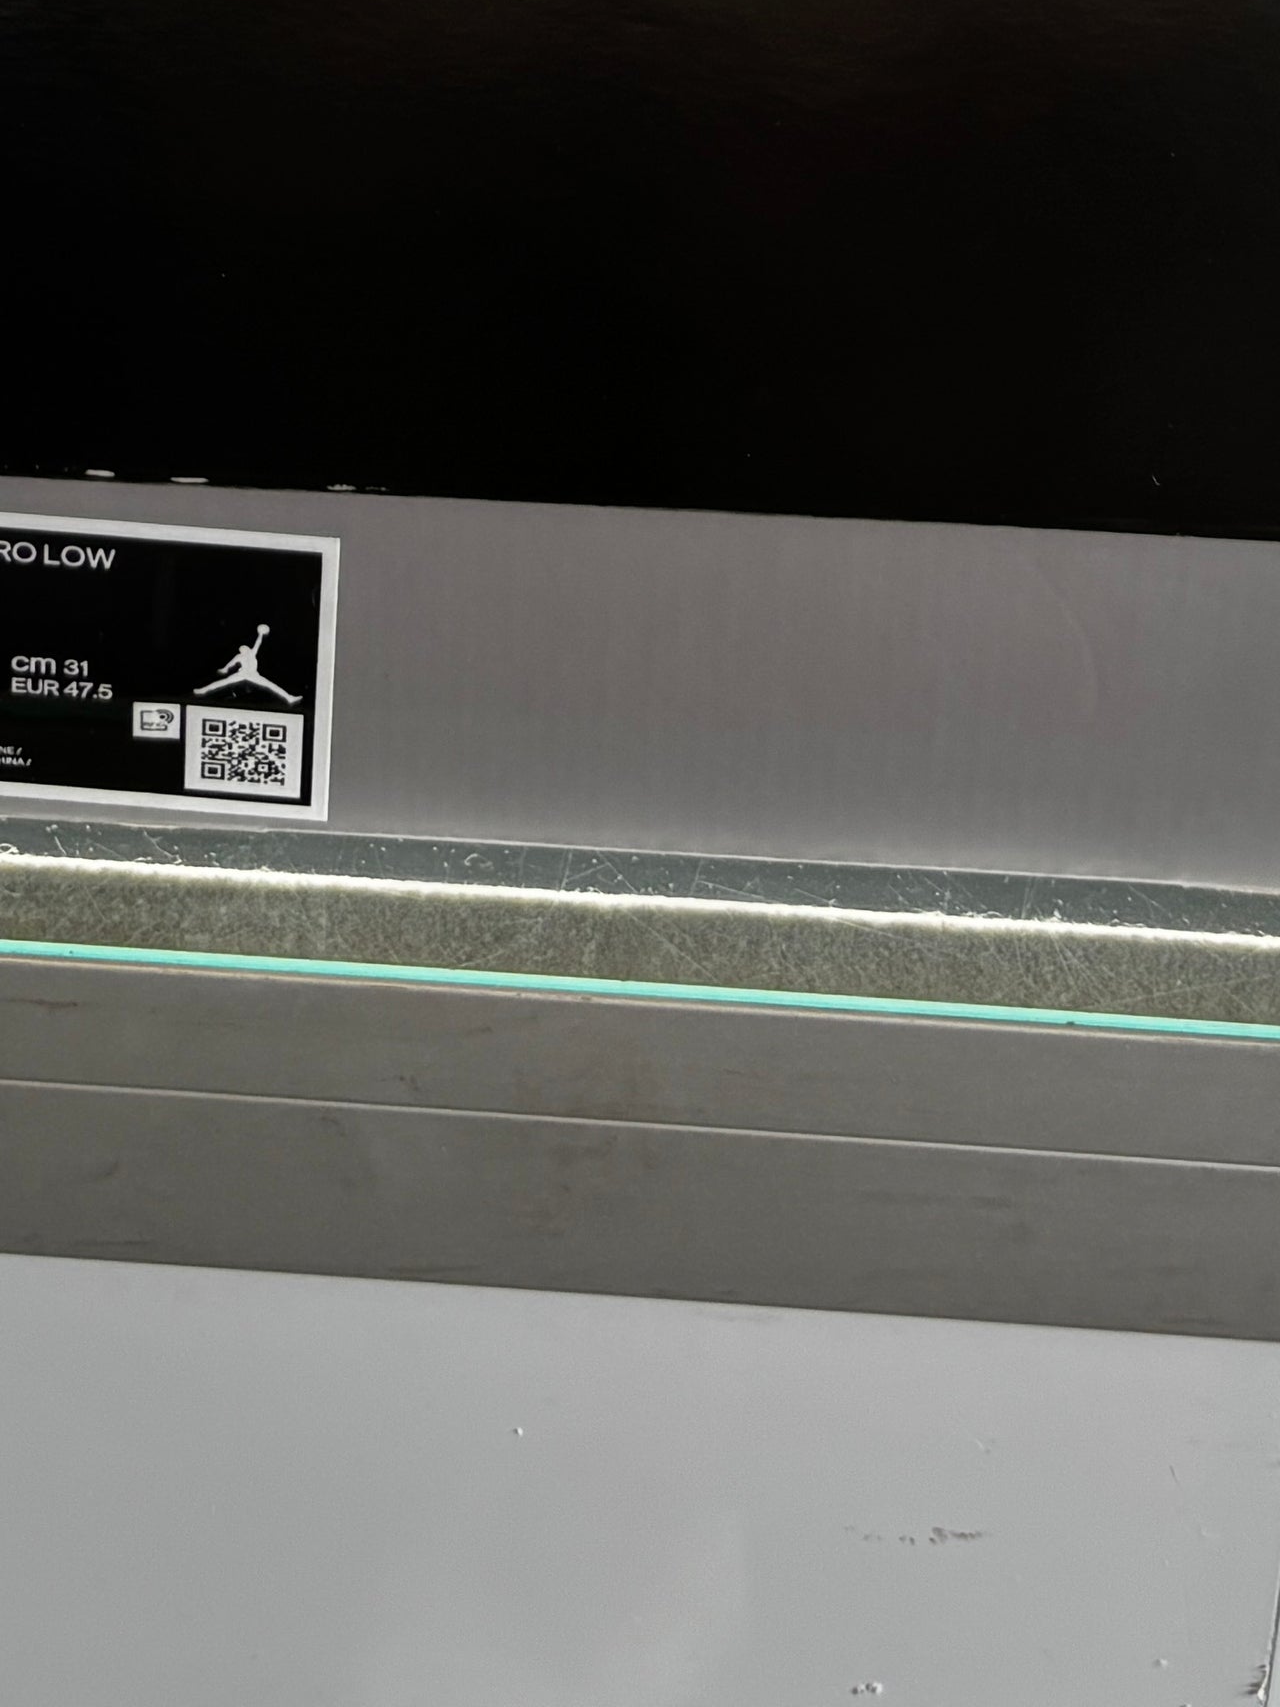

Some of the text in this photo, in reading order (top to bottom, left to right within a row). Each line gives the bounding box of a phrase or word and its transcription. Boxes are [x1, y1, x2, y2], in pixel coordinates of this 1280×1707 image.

[43, 543, 116, 570] LOW
[63, 659, 89, 677] 31
[10, 677, 114, 700] EUR 47.5
